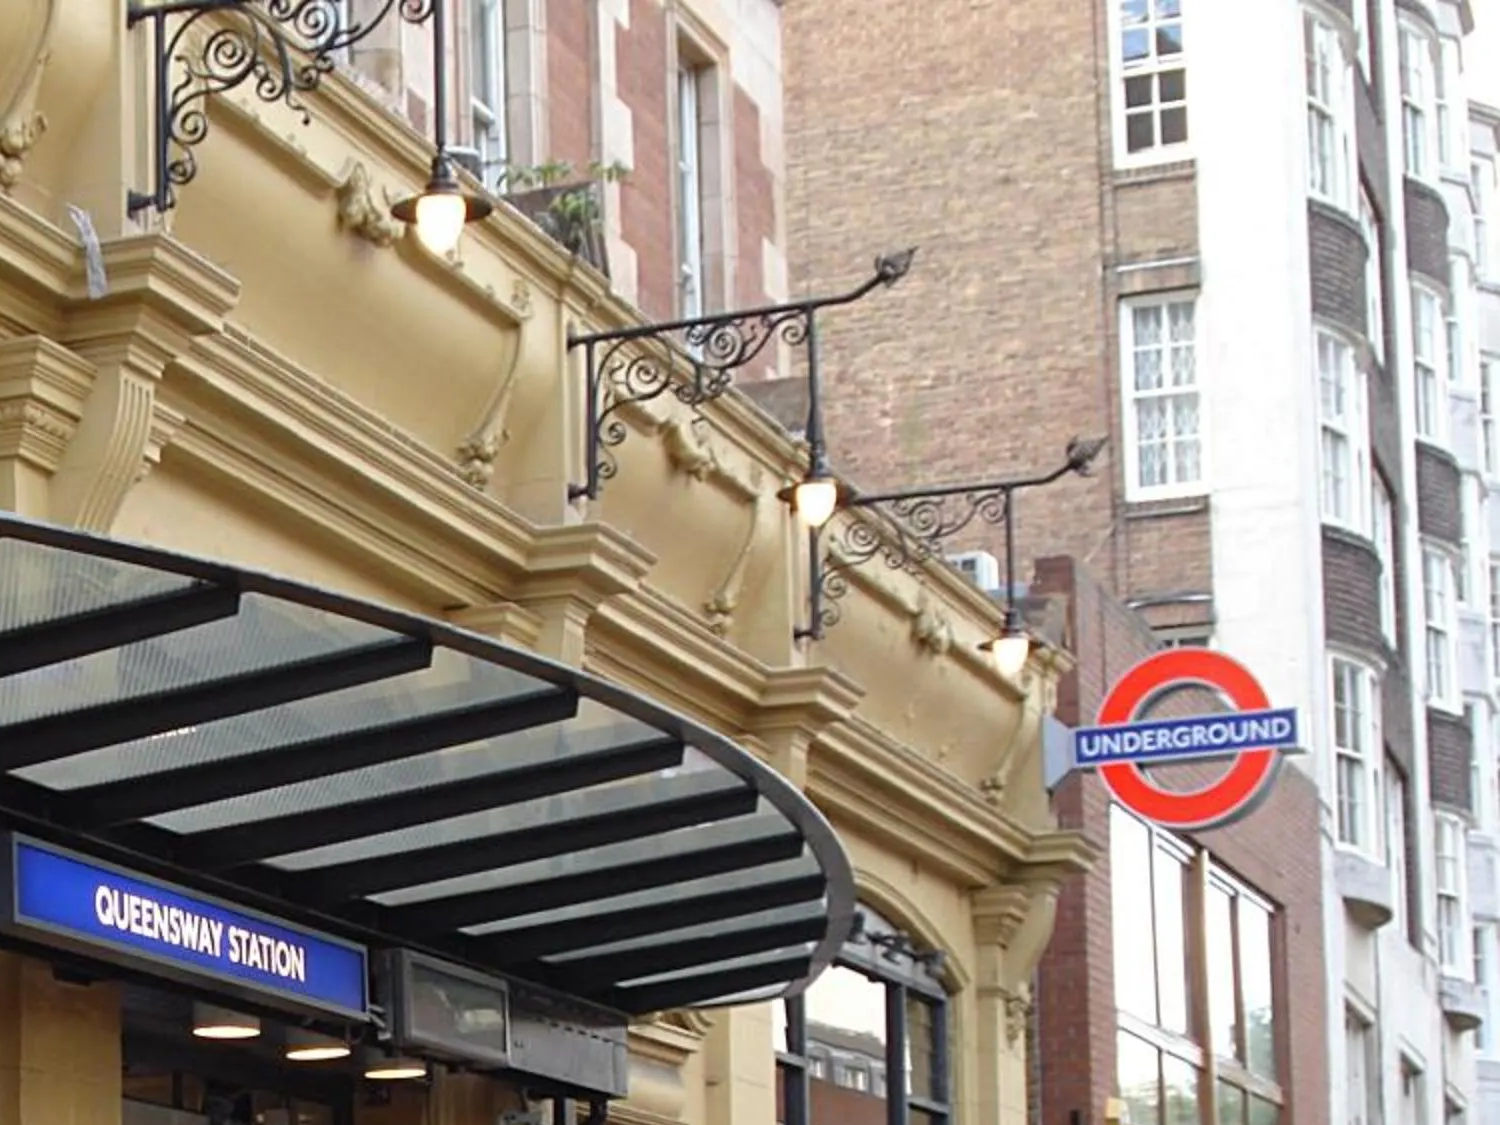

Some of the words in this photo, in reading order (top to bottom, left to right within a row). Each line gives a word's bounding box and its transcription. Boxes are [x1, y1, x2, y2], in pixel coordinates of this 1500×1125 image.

[1080, 717, 1291, 757] UNDERGROUND
[94, 885, 224, 958] QUEENSWAY
[228, 925, 306, 983] STATION
